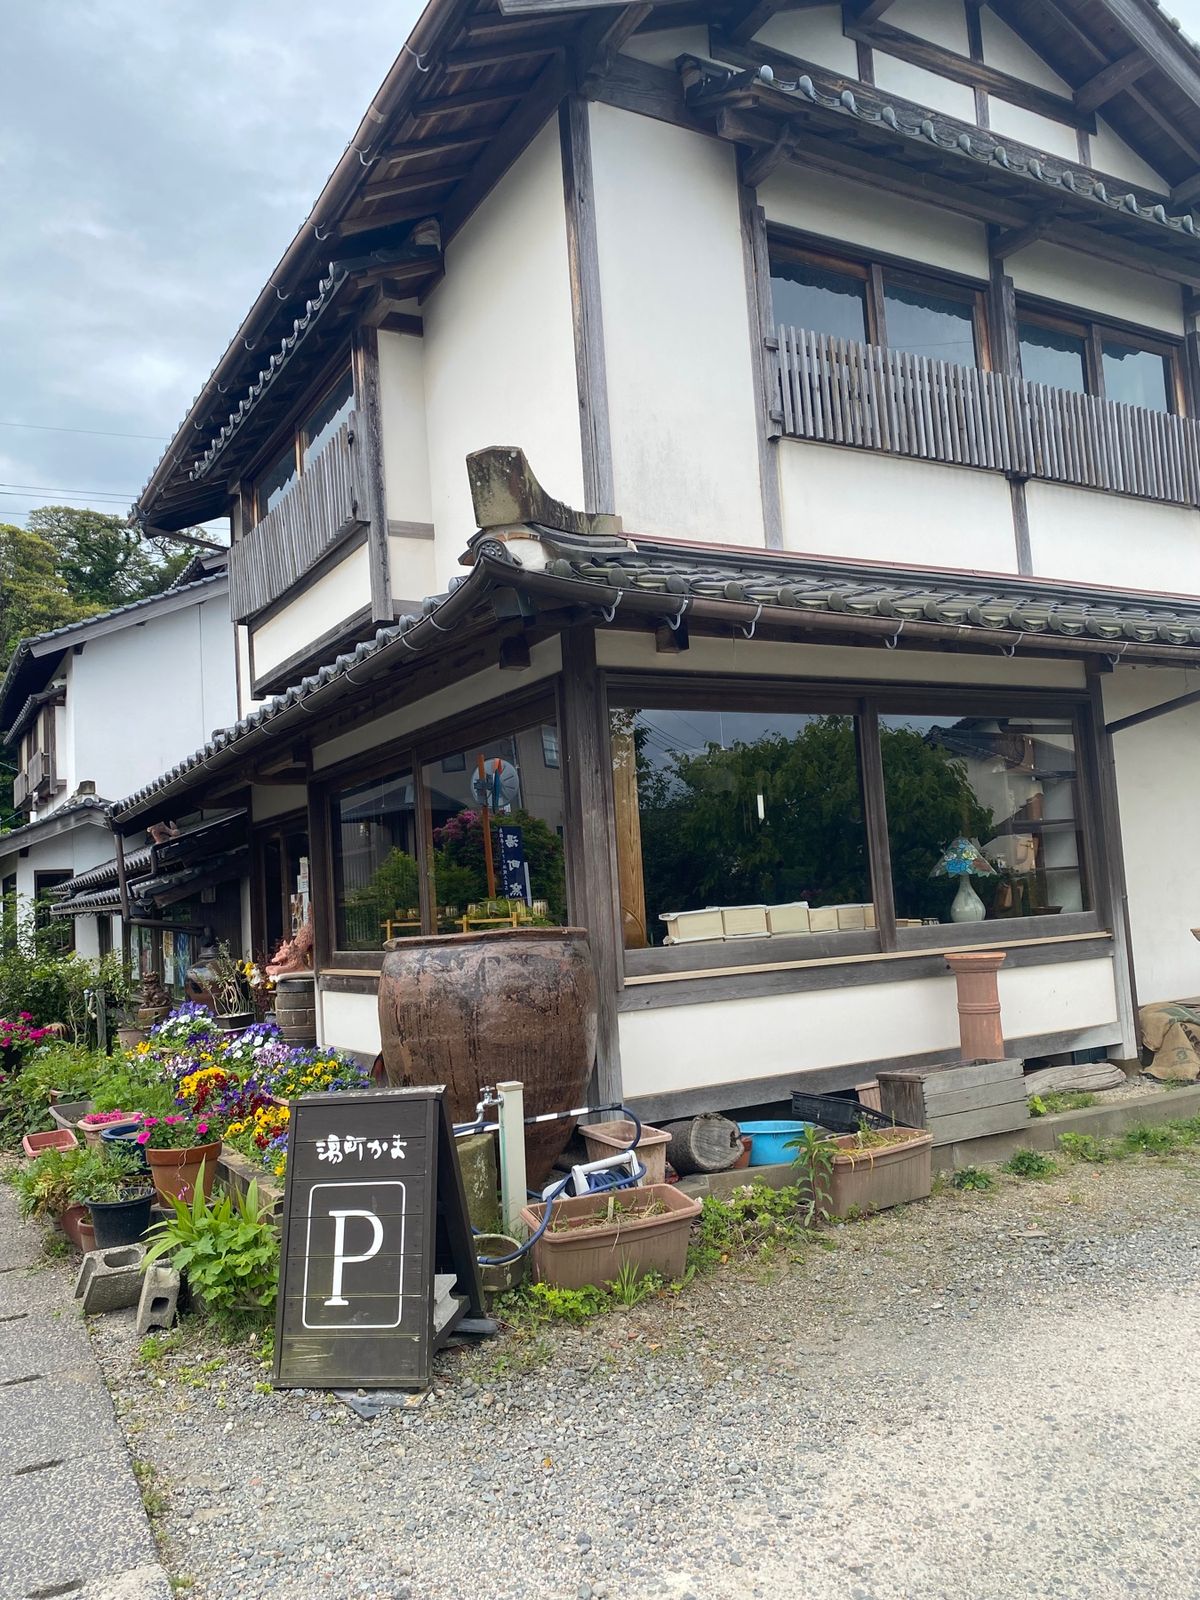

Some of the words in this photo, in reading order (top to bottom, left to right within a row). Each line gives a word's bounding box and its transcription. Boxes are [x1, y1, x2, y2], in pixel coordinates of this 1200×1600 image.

[315, 1134, 408, 1164] 湯町かま
[324, 1210, 384, 1306] P
